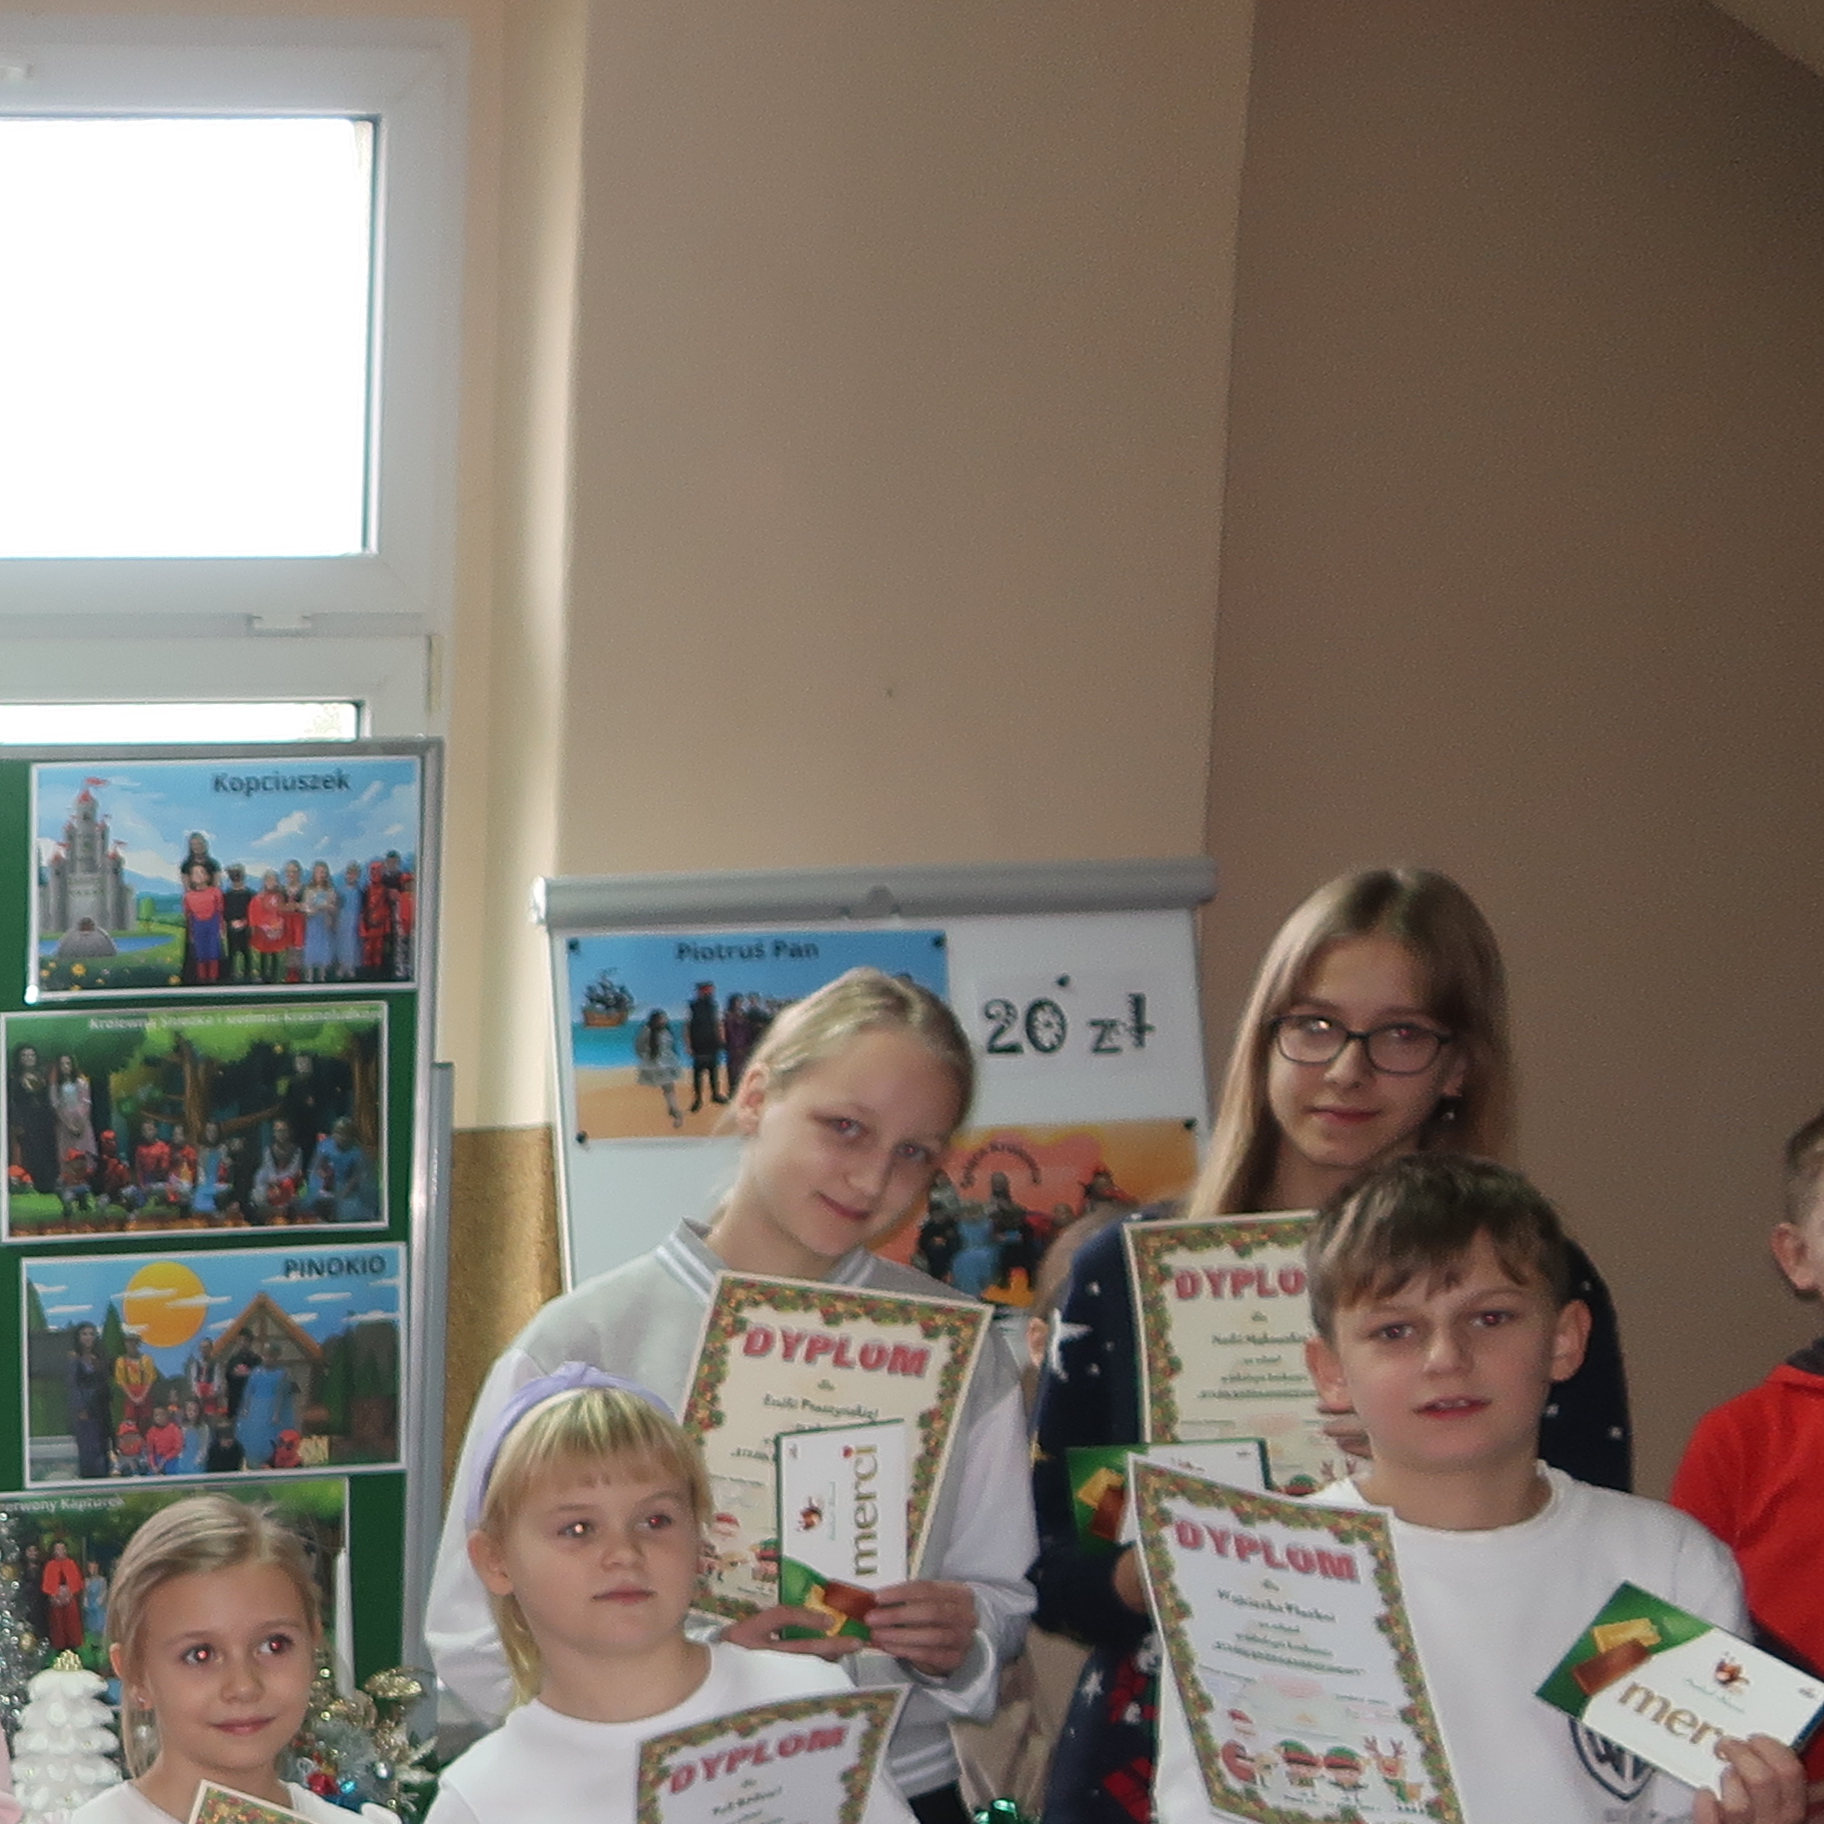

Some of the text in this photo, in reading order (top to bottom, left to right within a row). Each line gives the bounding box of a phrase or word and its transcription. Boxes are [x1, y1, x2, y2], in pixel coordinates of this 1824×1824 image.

[212, 769, 351, 797] Kopciuszek
[774, 939, 820, 960] Pan
[984, 992, 1156, 1056] 20 zł
[284, 1254, 387, 1278] PINOKIO
[1173, 1264, 1306, 1299] DYPLO
[742, 1323, 931, 1380] DYPLOM
[842, 1444, 878, 1576] merci
[1174, 1518, 1361, 1585] DYPLOM
[1619, 1682, 1723, 1744] mer
[669, 1725, 847, 1795] DYPLOM
